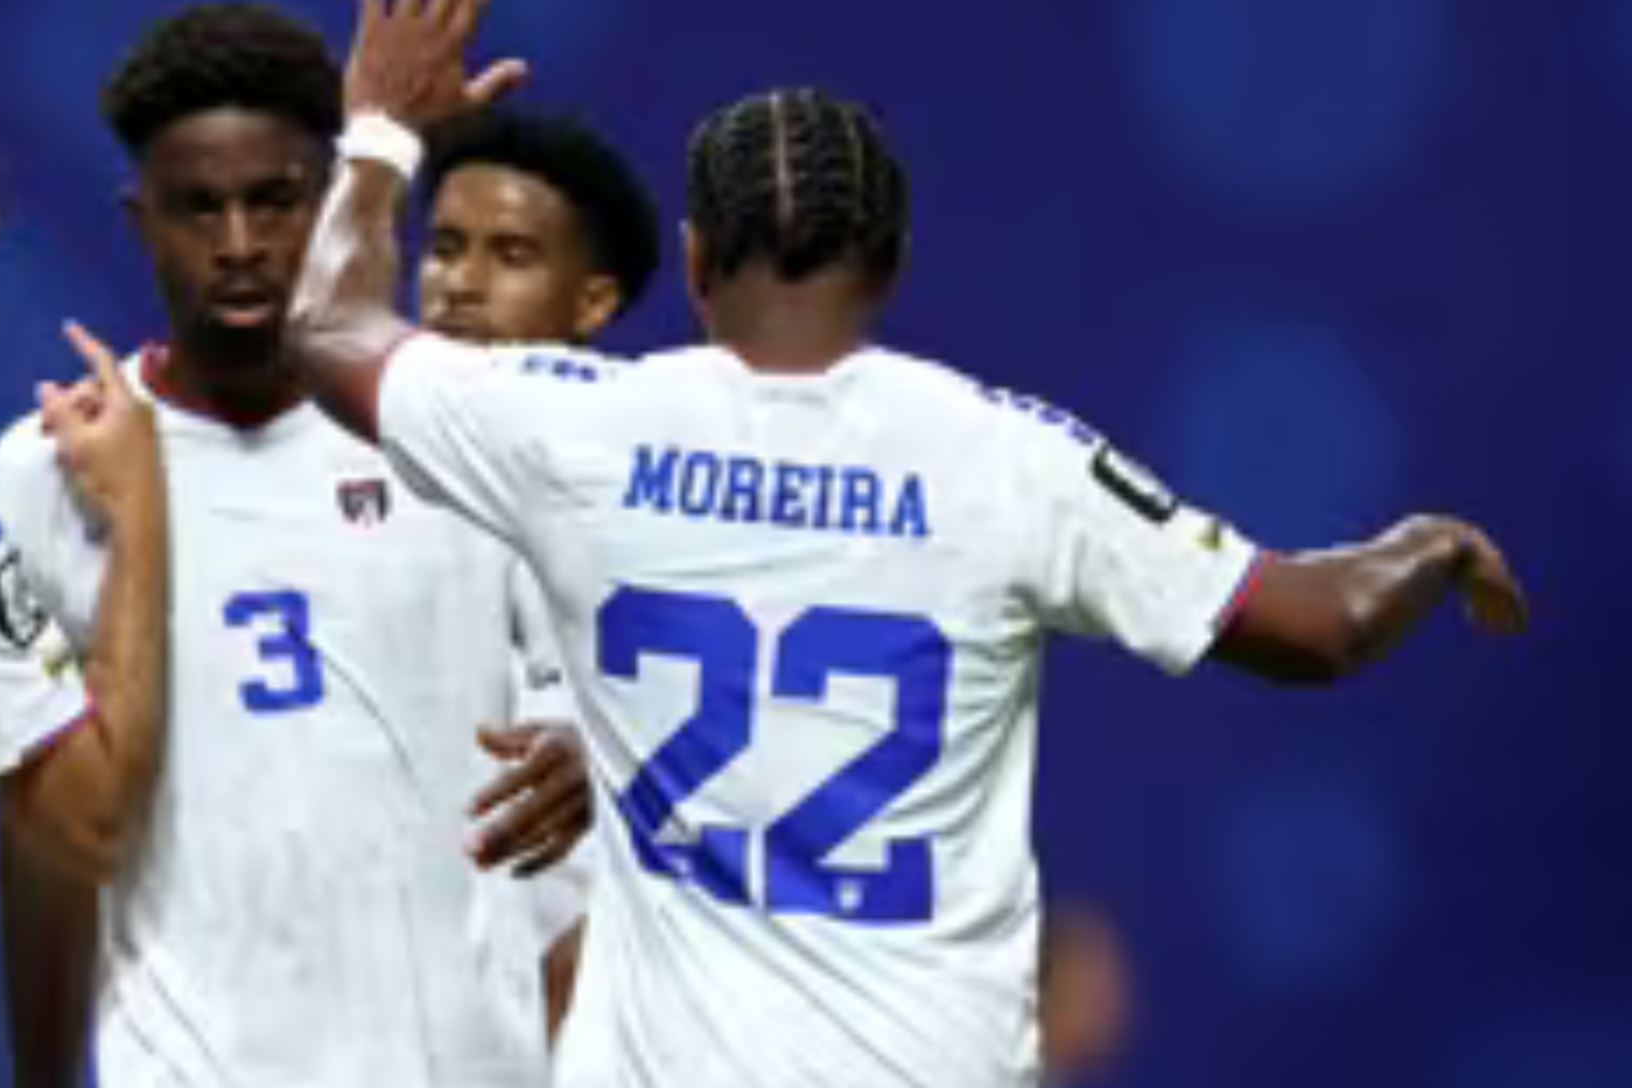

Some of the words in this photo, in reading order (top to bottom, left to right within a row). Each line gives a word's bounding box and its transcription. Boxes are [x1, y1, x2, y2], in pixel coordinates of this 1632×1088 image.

[622, 446, 930, 536] MOREIRA
[223, 591, 325, 713] 3
[596, 583, 952, 924] 22
